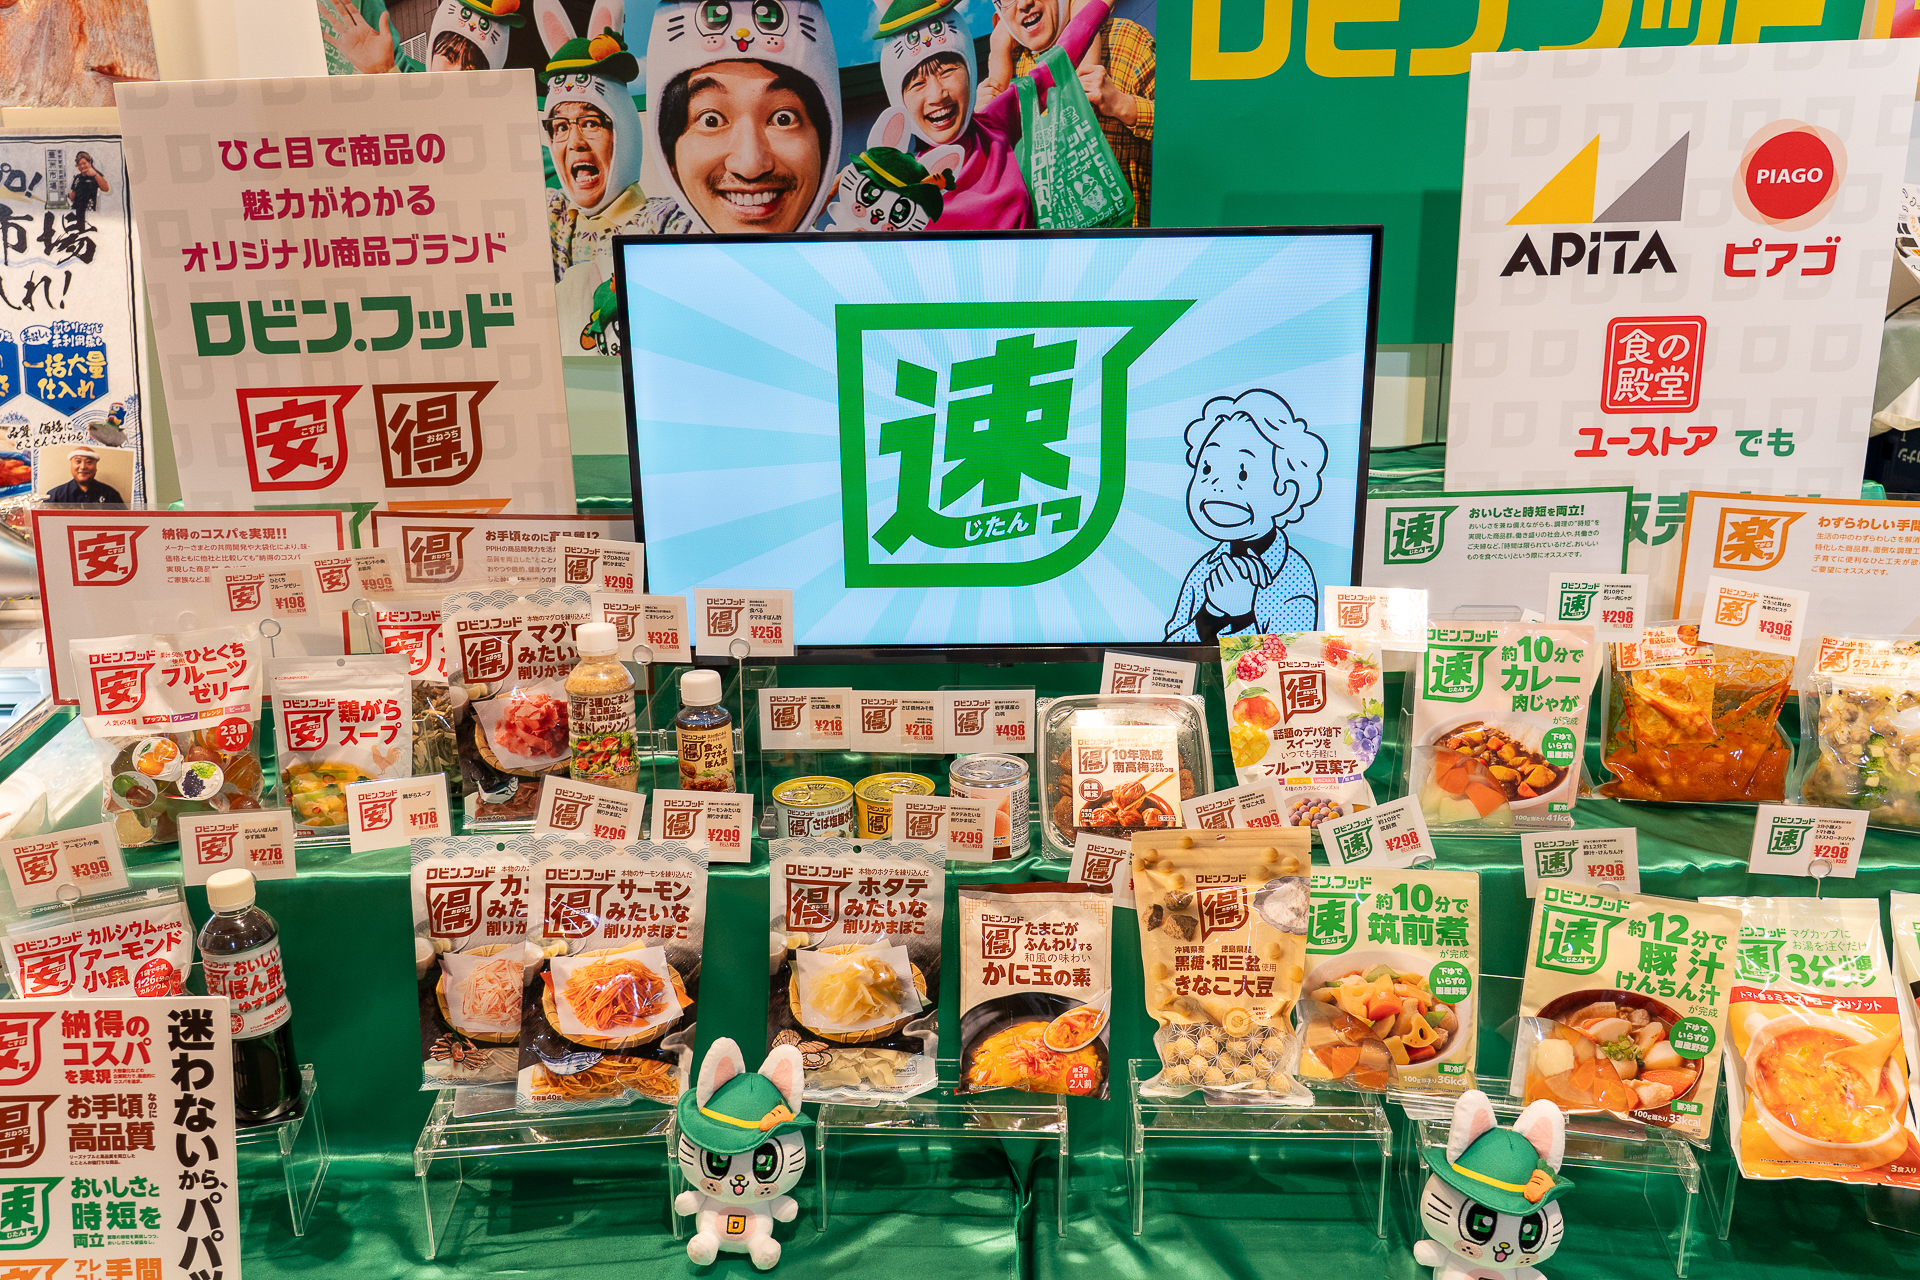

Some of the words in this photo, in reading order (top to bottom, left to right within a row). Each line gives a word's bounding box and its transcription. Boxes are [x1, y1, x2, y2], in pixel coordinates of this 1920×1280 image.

[217, 133, 446, 171] ひと目で商品の
[1756, 167, 1824, 185] PIAGO
[242, 184, 436, 221] 魅力がわかる
[181, 232, 508, 272] オリジナル商品ブランド
[1723, 235, 1843, 278] ピアゴ
[1617, 328, 1691, 365] 食の
[23, 351, 107, 379] 一括大量
[37, 378, 96, 400] 仕入れ
[1613, 365, 1690, 403] 殿堂
[426, 428, 460, 444] おねうち
[1574, 426, 1718, 457] ユーストア
[1734, 427, 1796, 457] でも
[1469, 505, 1585, 519] おいしさと時短を両立!
[964, 511, 1030, 542] じたん
[604, 575, 633, 589] ¥299
[1602, 610, 1633, 624] ¥298
[750, 626, 782, 639] ¥258
[1759, 619, 1792, 636] ¥398
[648, 632, 679, 644] ¥328
[184, 642, 246, 664] ひとくち
[1501, 636, 1584, 663] 約10分で
[161, 659, 248, 687] フルーツ
[1501, 664, 1581, 692] カレー
[189, 683, 250, 704] ゼリー
[338, 699, 401, 723] 鶏がら
[1511, 695, 1579, 712] 肉じゃが
[220, 724, 249, 736] 23個
[815, 719, 842, 731] ¥218
[905, 724, 933, 736] ¥218
[995, 724, 1025, 736] ¥498
[1273, 726, 1342, 740] 話題のデパ地下
[225, 735, 247, 747] 入り
[339, 722, 402, 746] スープ
[1286, 739, 1331, 749] スイーツを
[1112, 749, 1164, 761] 10年熟成
[1281, 749, 1337, 759] いつでも手軽に!
[1113, 761, 1150, 774] 南高梅
[410, 811, 438, 826] ¥178
[708, 828, 741, 842] ¥299
[951, 831, 983, 844] ¥299
[1385, 831, 1419, 851] ¥298
[250, 847, 283, 861] ¥278
[1813, 845, 1849, 858] ¥298
[71, 860, 110, 877] ¥399
[621, 869, 693, 879] 本物のサーモンを練り込んだ
[858, 867, 930, 877] 本物のホタテを練り込んだ
[1587, 863, 1626, 877] ¥298
[617, 879, 691, 901] サーモン
[858, 877, 929, 898] ホタテ
[1375, 883, 1469, 913] 約10分で
[605, 902, 690, 923] みたいな
[844, 899, 928, 919] みたいな
[603, 926, 689, 940] 削りかまぼこ
[842, 918, 926, 935] 削りかまぼこ
[1024, 921, 1080, 936] たまごが
[1367, 913, 1470, 948] 筑前煮
[1627, 911, 1728, 951] 約12分で
[1790, 928, 1851, 939] マグカップに
[79, 930, 183, 971] アーモンド
[1024, 937, 1092, 951] ふんわりする
[1174, 946, 1206, 954] 沖縄県産
[233, 948, 279, 976] おいしい
[1024, 952, 1092, 963] 和風の味わい
[1439, 949, 1470, 960] が完成
[1438, 967, 1464, 976] 下ゆで
[1636, 941, 1726, 986] 豚汁
[82, 965, 130, 993] 小魚
[228, 964, 281, 1000] ぽん酢
[982, 961, 1092, 988] かに玉の素
[1436, 976, 1466, 986] いらずの
[1174, 975, 1275, 998] きなこ大豆
[1435, 985, 1468, 996] 国産野菜
[1615, 969, 1721, 1006] けんちん汁
[1687, 1004, 1719, 1018] が完成
[62, 1010, 150, 1038] 納得の
[1683, 1021, 1709, 1033] 下ゆで
[1677, 1031, 1710, 1043] いらずの
[63, 1038, 152, 1067] コスパ
[65, 1069, 112, 1084] を実現
[1069, 1078, 1092, 1089] 2人前
[67, 1093, 145, 1120] お手頃
[148, 1092, 158, 1119] なのに
[67, 1121, 156, 1152] 高品質
[1890, 1163, 1918, 1174] 3食入り
[71, 1176, 160, 1199] おいしさと
[71, 1201, 162, 1231] 時短を
[73, 1233, 105, 1249] 両立
